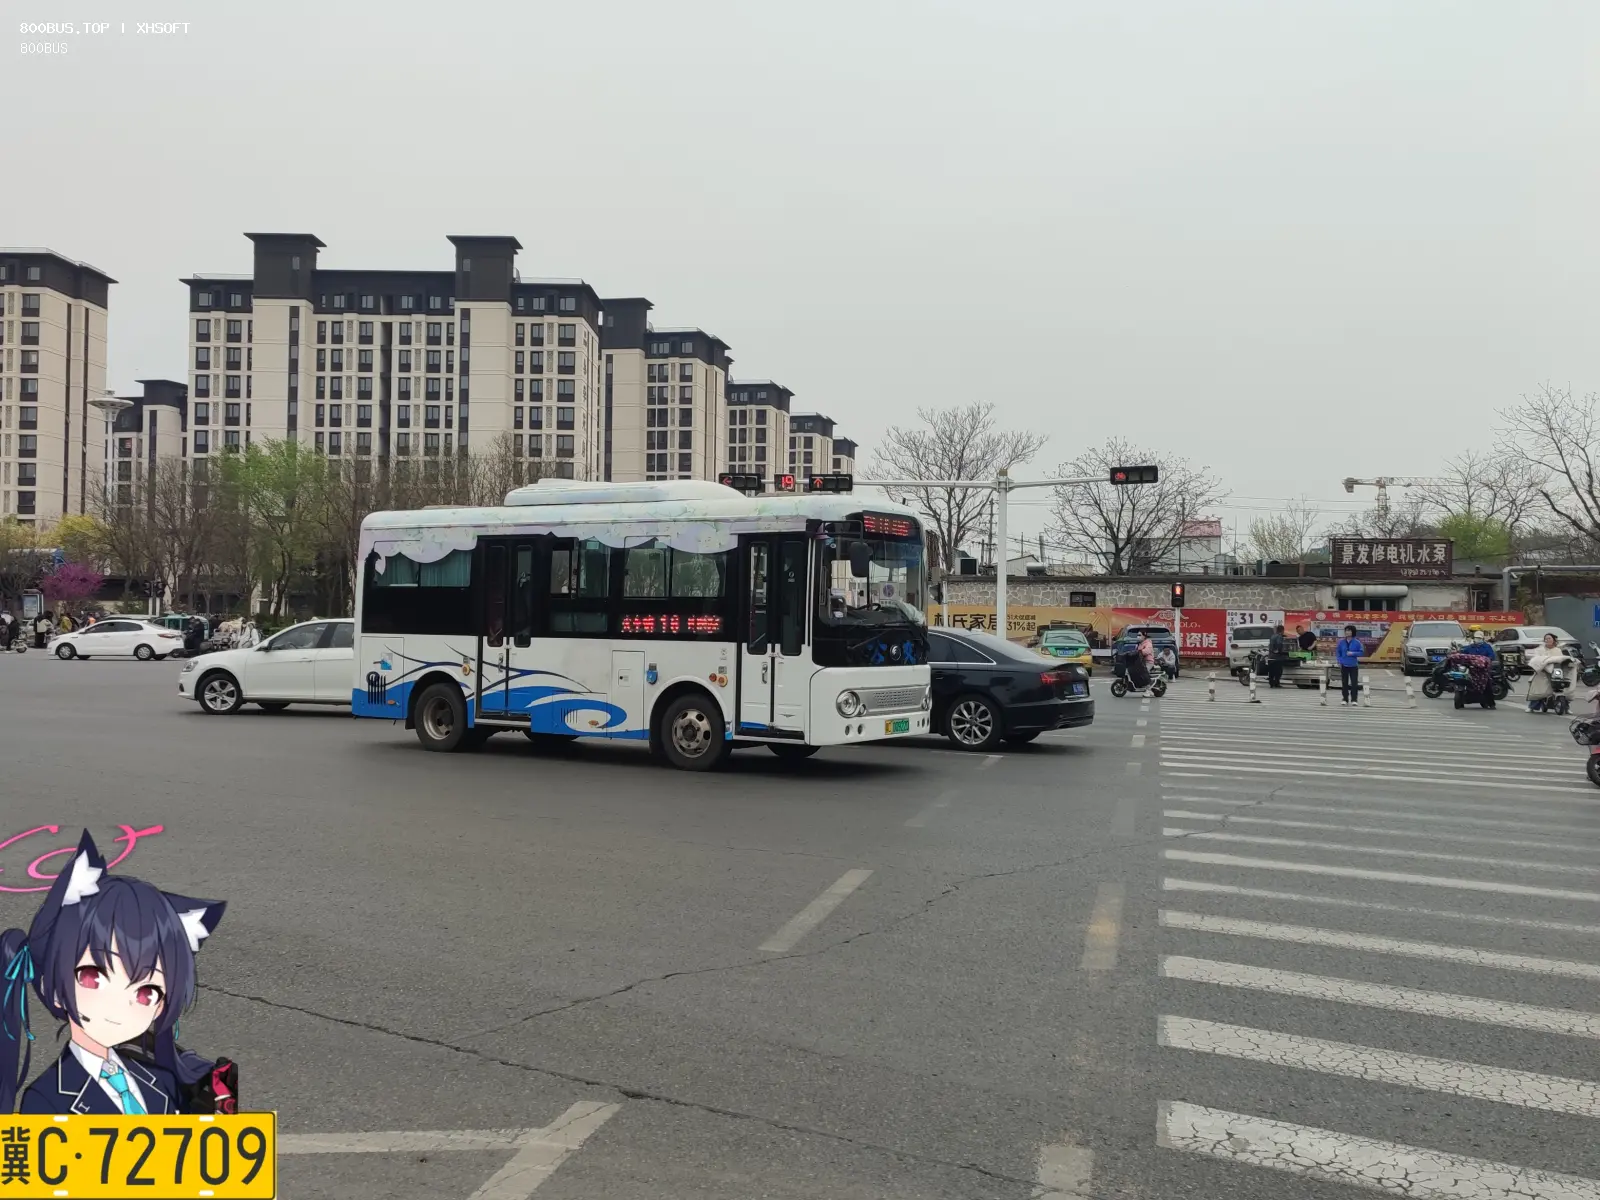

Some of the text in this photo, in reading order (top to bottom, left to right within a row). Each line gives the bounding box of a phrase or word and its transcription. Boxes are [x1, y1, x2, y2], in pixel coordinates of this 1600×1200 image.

[781, 475, 794, 490] 19
[1341, 543, 1447, 565] 景发修电机水泵
